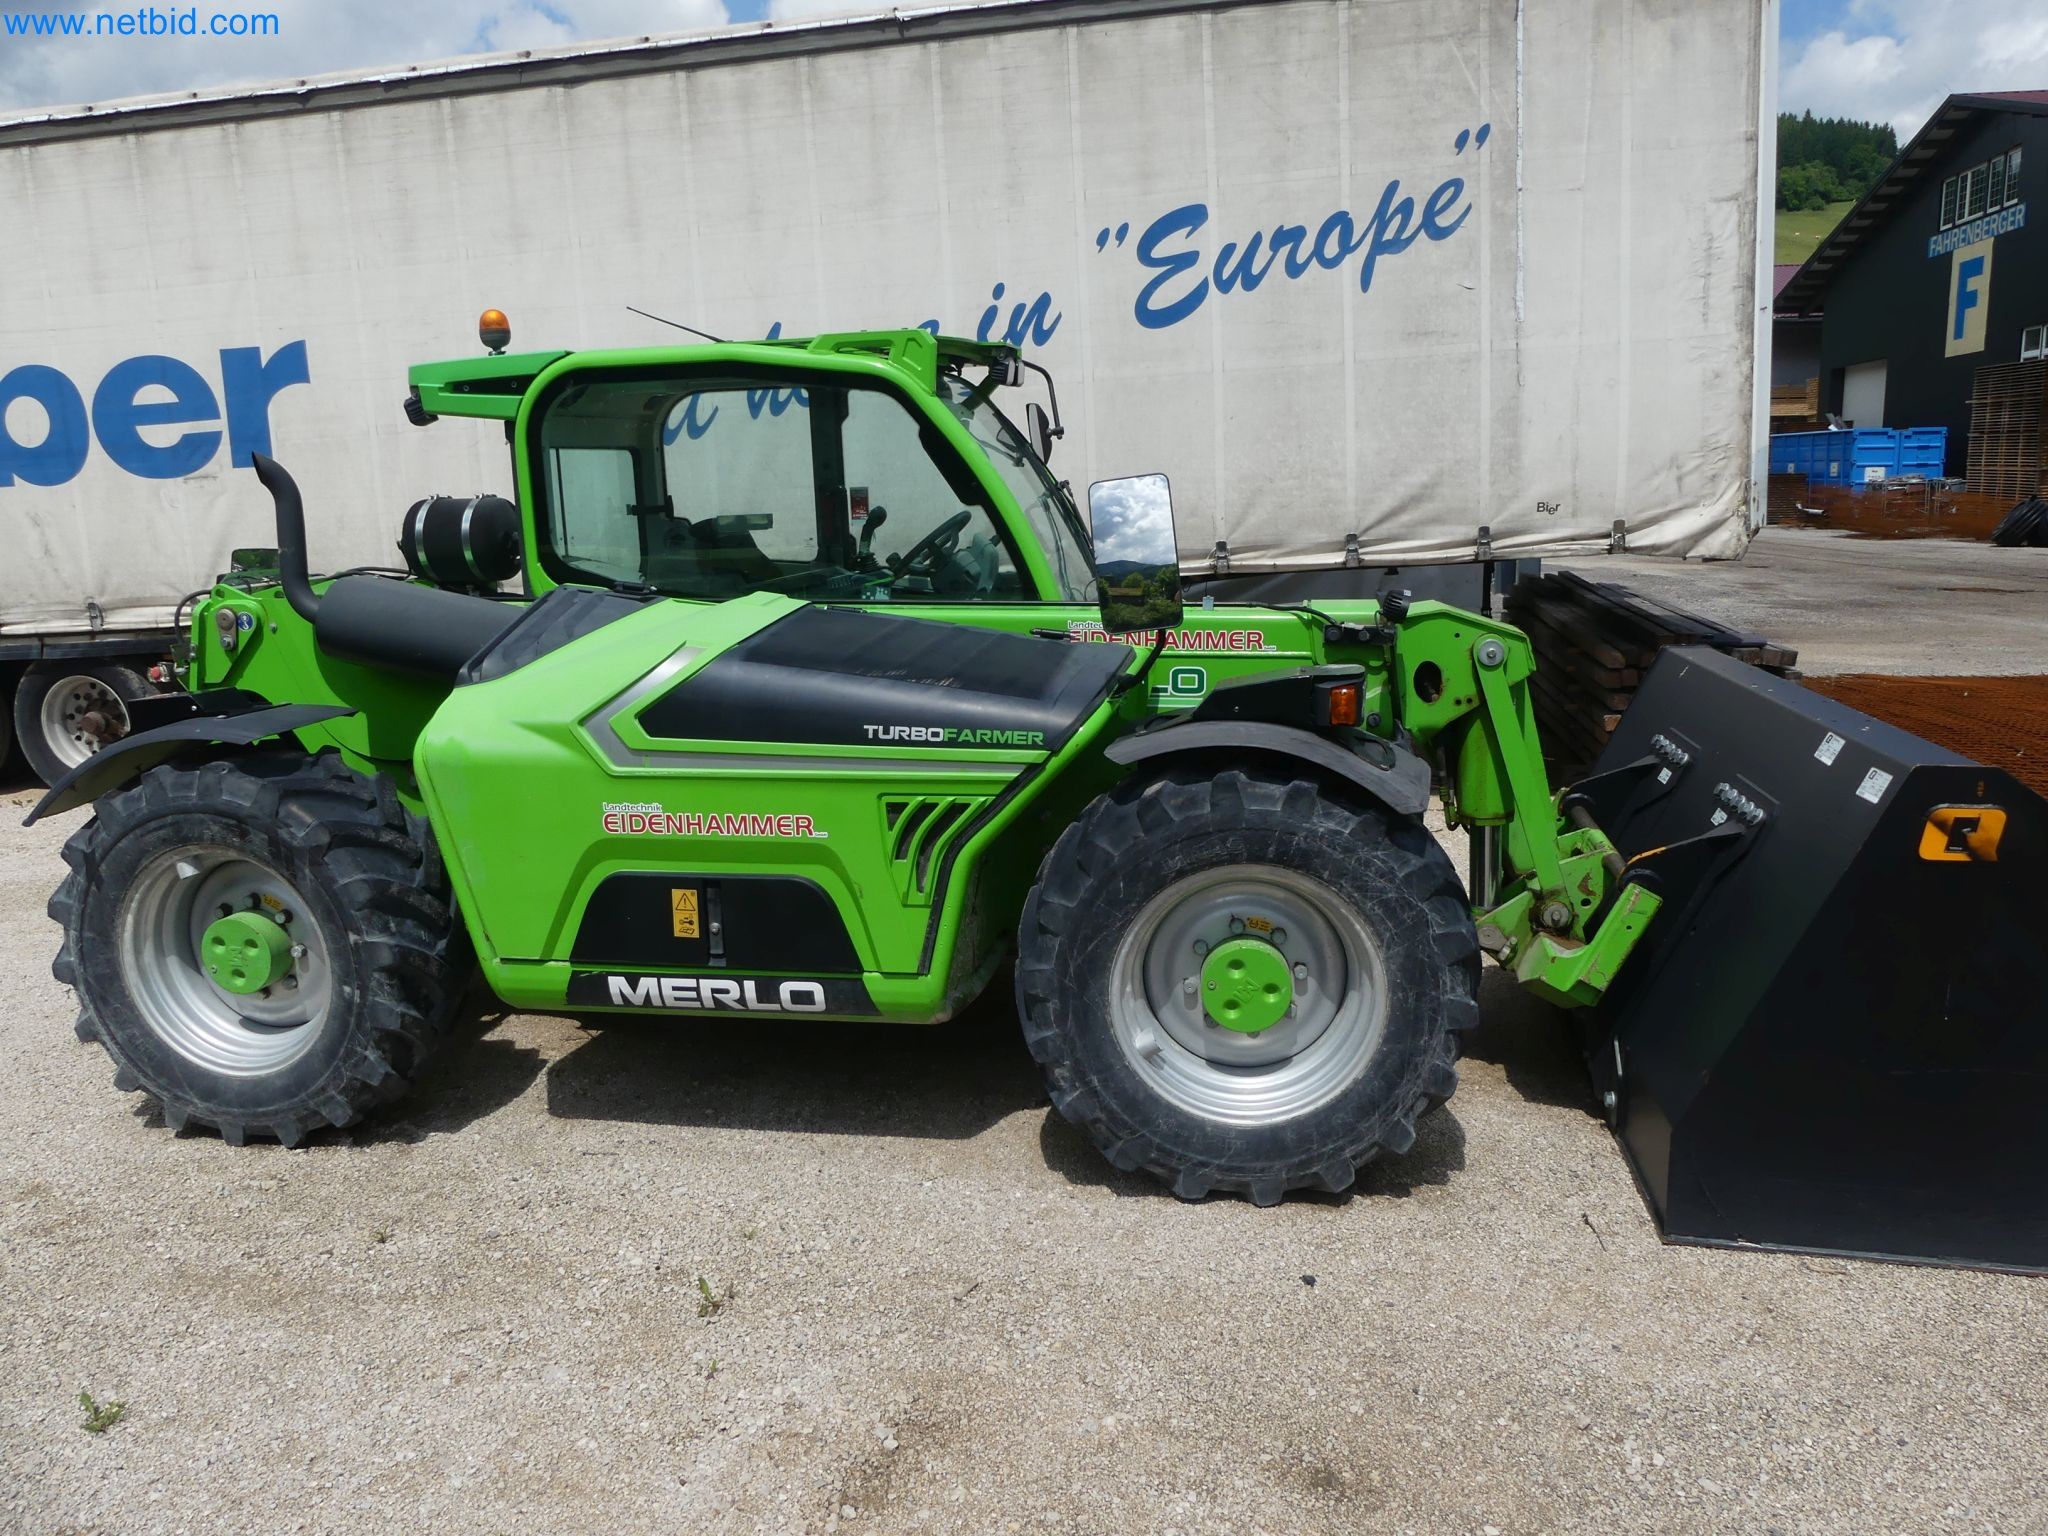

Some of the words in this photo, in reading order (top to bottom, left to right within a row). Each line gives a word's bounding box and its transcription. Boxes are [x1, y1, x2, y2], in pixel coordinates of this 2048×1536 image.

[1928, 204, 2026, 258] FAHRENBERGER
[1953, 255, 1985, 340] F
[1068, 620, 1104, 629] Landtec
[863, 724, 1044, 746] TURBOFARMER
[602, 802, 662, 812] Landtechnik
[603, 812, 815, 837] EIDENHAMMER
[607, 975, 826, 1012] MERLO
